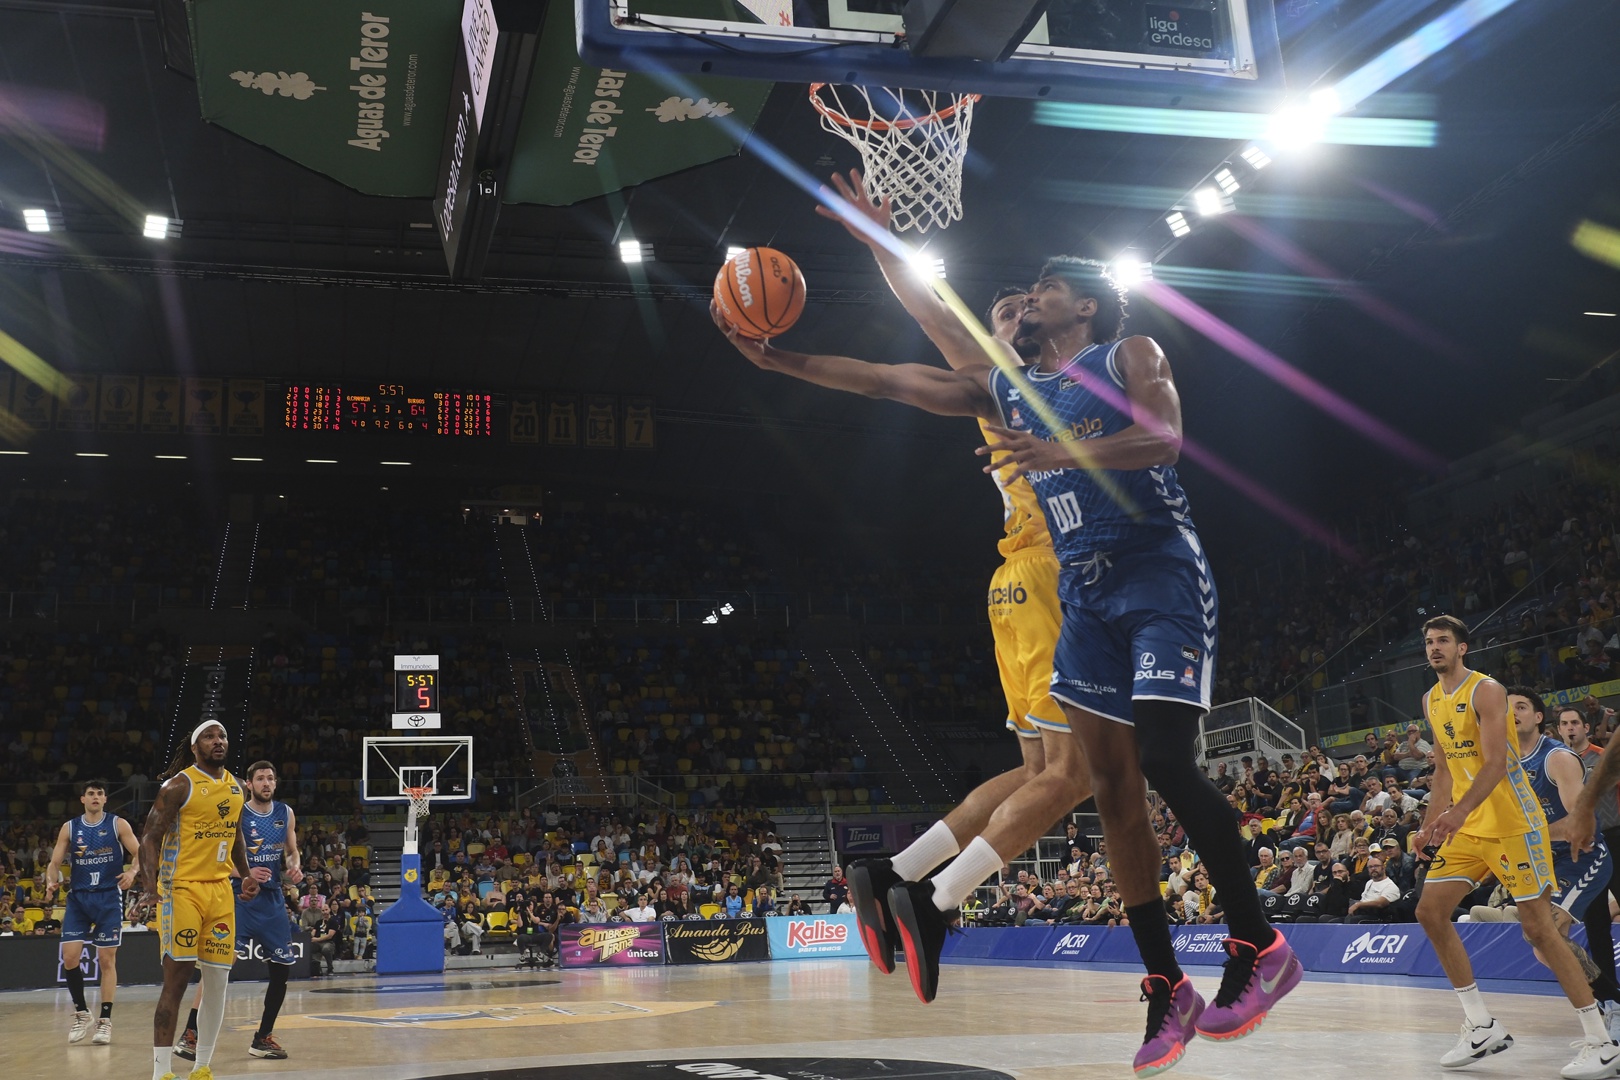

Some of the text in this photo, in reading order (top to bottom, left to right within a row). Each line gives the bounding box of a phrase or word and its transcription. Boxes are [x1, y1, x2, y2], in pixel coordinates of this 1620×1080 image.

[1149, 16, 1178, 33] liga
[1151, 33, 1212, 48] endesa
[348, 12, 390, 151] Aguas de Teror
[403, 54, 418, 126] www.aguasdeteror.com
[553, 66, 581, 138] www.aguasdeteror.com
[586, 100, 624, 125] de
[572, 126, 618, 165] Teror
[440, 113, 467, 242] Lopesan.com
[734, 250, 754, 308] Wilson
[379, 384, 404, 396] 5:57
[352, 402, 426, 415] 57 3 64
[351, 419, 357, 427] 4
[375, 420, 381, 428] 9
[384, 420, 390, 429] 2
[398, 421, 404, 429] 6
[422, 422, 428, 430] 4
[513, 415, 535, 436] 20
[554, 416, 571, 438] 11
[633, 420, 644, 441] 7
[1047, 491, 1084, 534] 00
[1183, 650, 1195, 659] acb
[407, 674, 434, 686] 5:57
[1133, 669, 1176, 681] EXUS
[417, 687, 430, 708] 5
[1099, 685, 1117, 693] LEÓN
[194, 821, 237, 830] DREAMLA
[847, 828, 880, 841] Tirma
[216, 840, 228, 863] 6
[79, 856, 108, 866] BURGOS
[668, 921, 765, 938] Amanda Bus
[788, 920, 848, 947] Kalise
[1193, 933, 1229, 941] GRUPO
[205, 939, 231, 949] Poema
[627, 949, 659, 958] únicas
